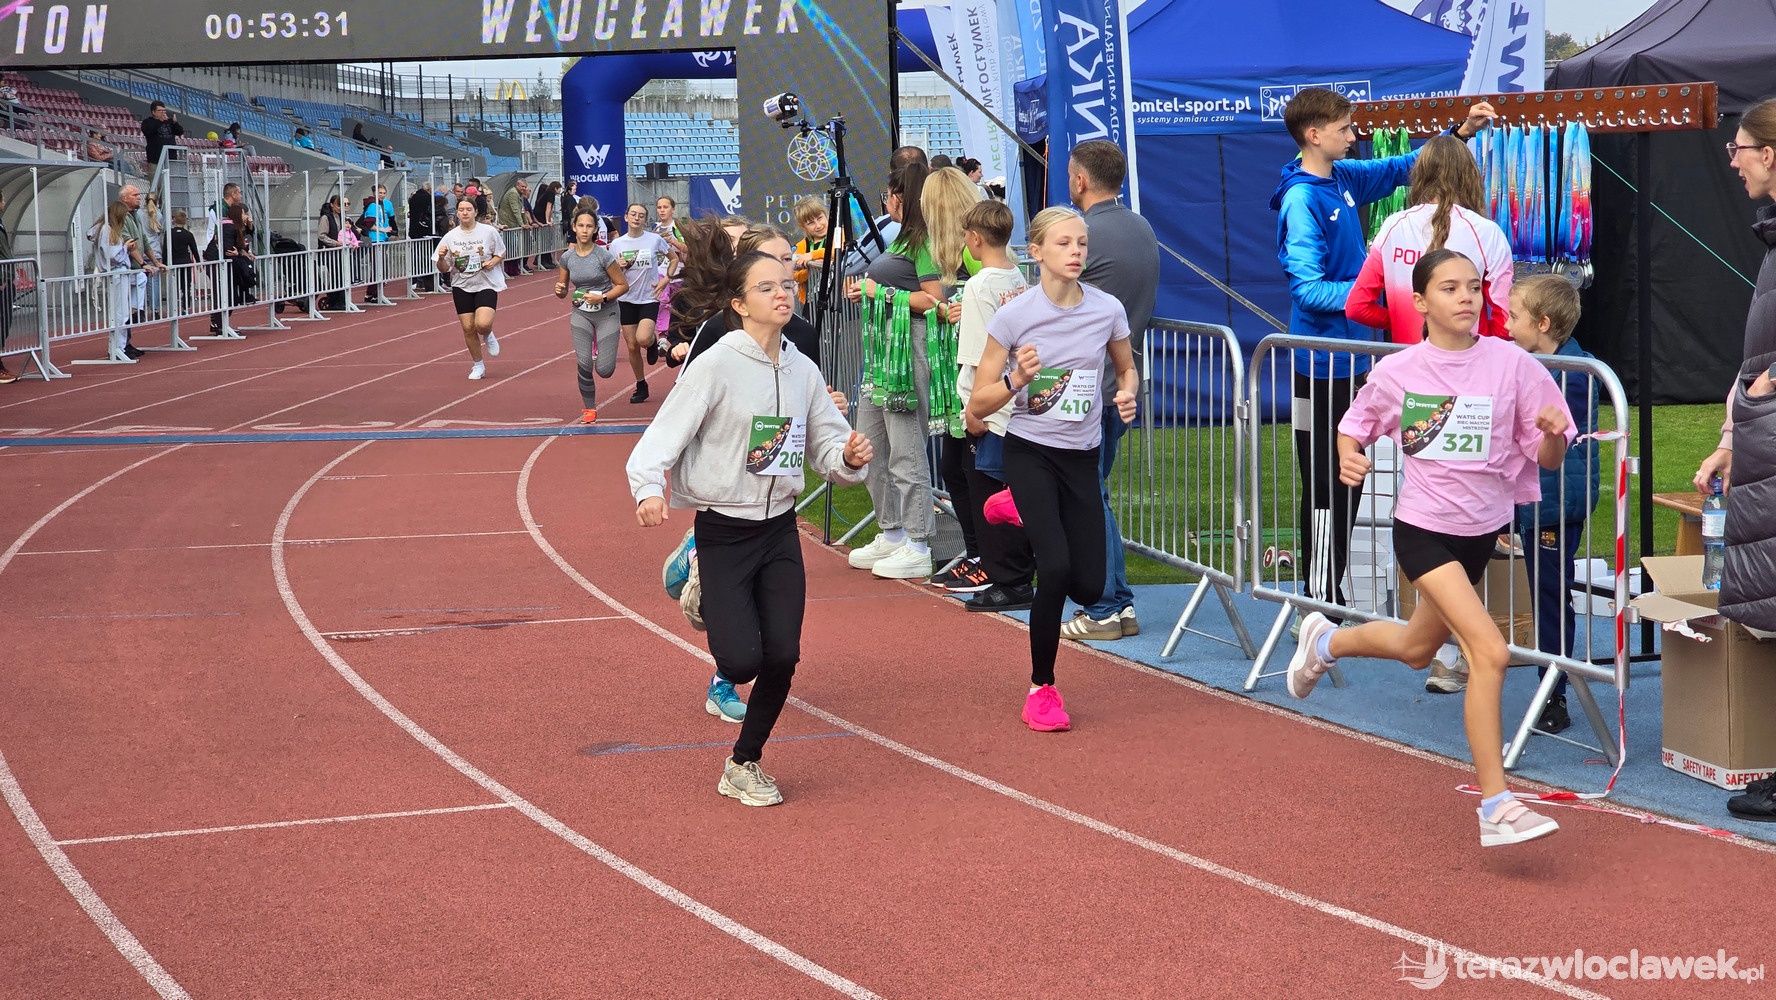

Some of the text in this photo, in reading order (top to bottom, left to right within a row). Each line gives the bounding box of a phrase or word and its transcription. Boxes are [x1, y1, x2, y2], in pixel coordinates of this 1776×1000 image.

[205, 11, 348, 40] 00:53:31
[1132, 96, 1252, 115] omtel-sport.pl
[1137, 116, 1171, 124] systemy
[1173, 115, 1208, 123] pomiaru
[569, 173, 620, 183] WŁOCŁAWEK
[1060, 399, 1092, 415] 410
[1442, 433, 1483, 453] 321
[779, 451, 804, 468] 206
[1662, 751, 1675, 765] TAPE
[1683, 758, 1701, 777] SAFETY
[1702, 765, 1716, 781] TAPE
